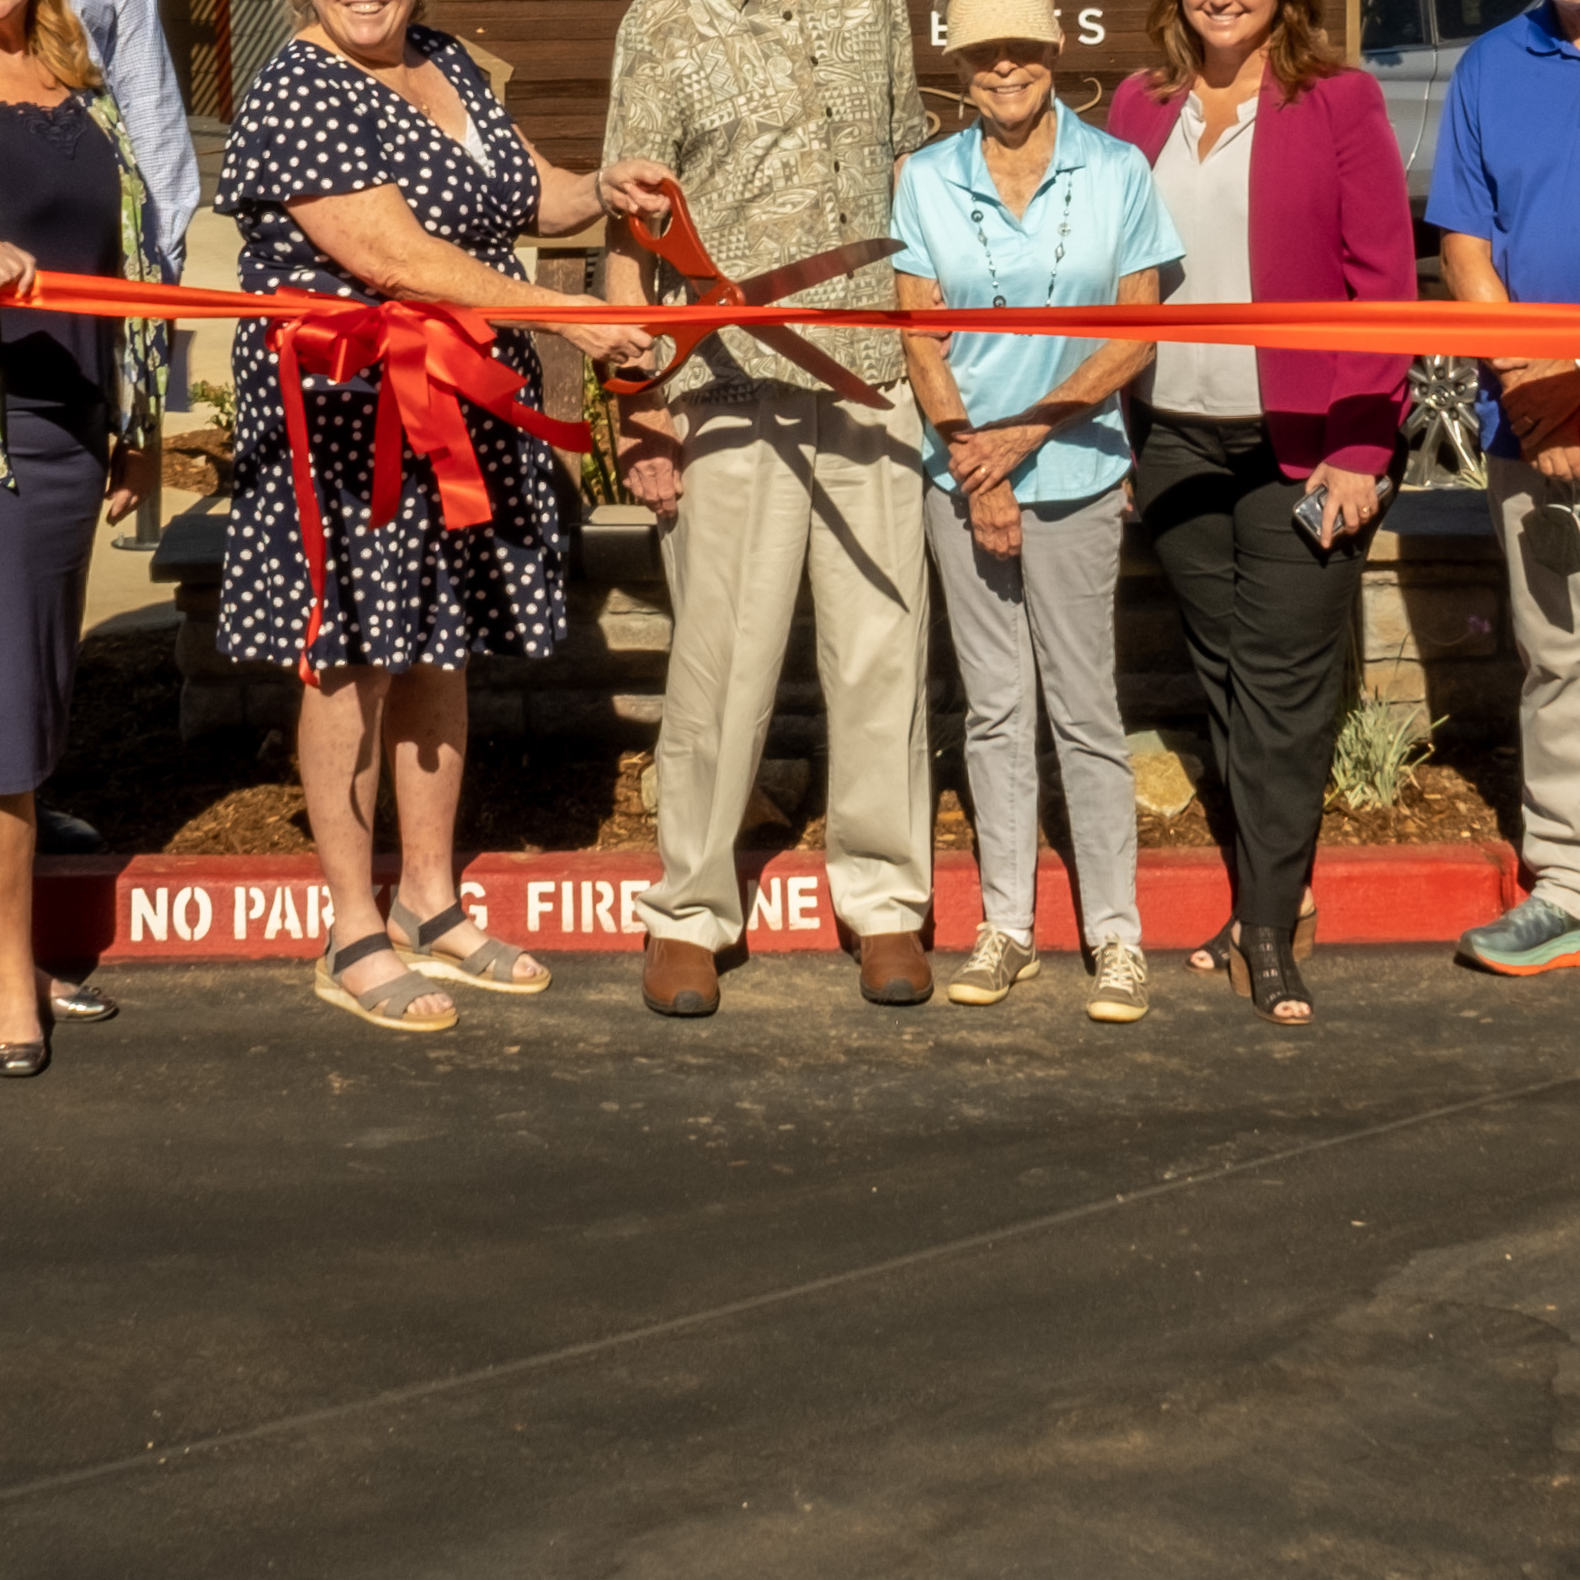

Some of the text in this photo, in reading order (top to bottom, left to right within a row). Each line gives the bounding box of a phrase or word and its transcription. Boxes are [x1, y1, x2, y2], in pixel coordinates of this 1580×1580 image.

[130, 886, 213, 942] NO
[234, 881, 489, 940] PARG
[527, 879, 652, 934] FIRE
